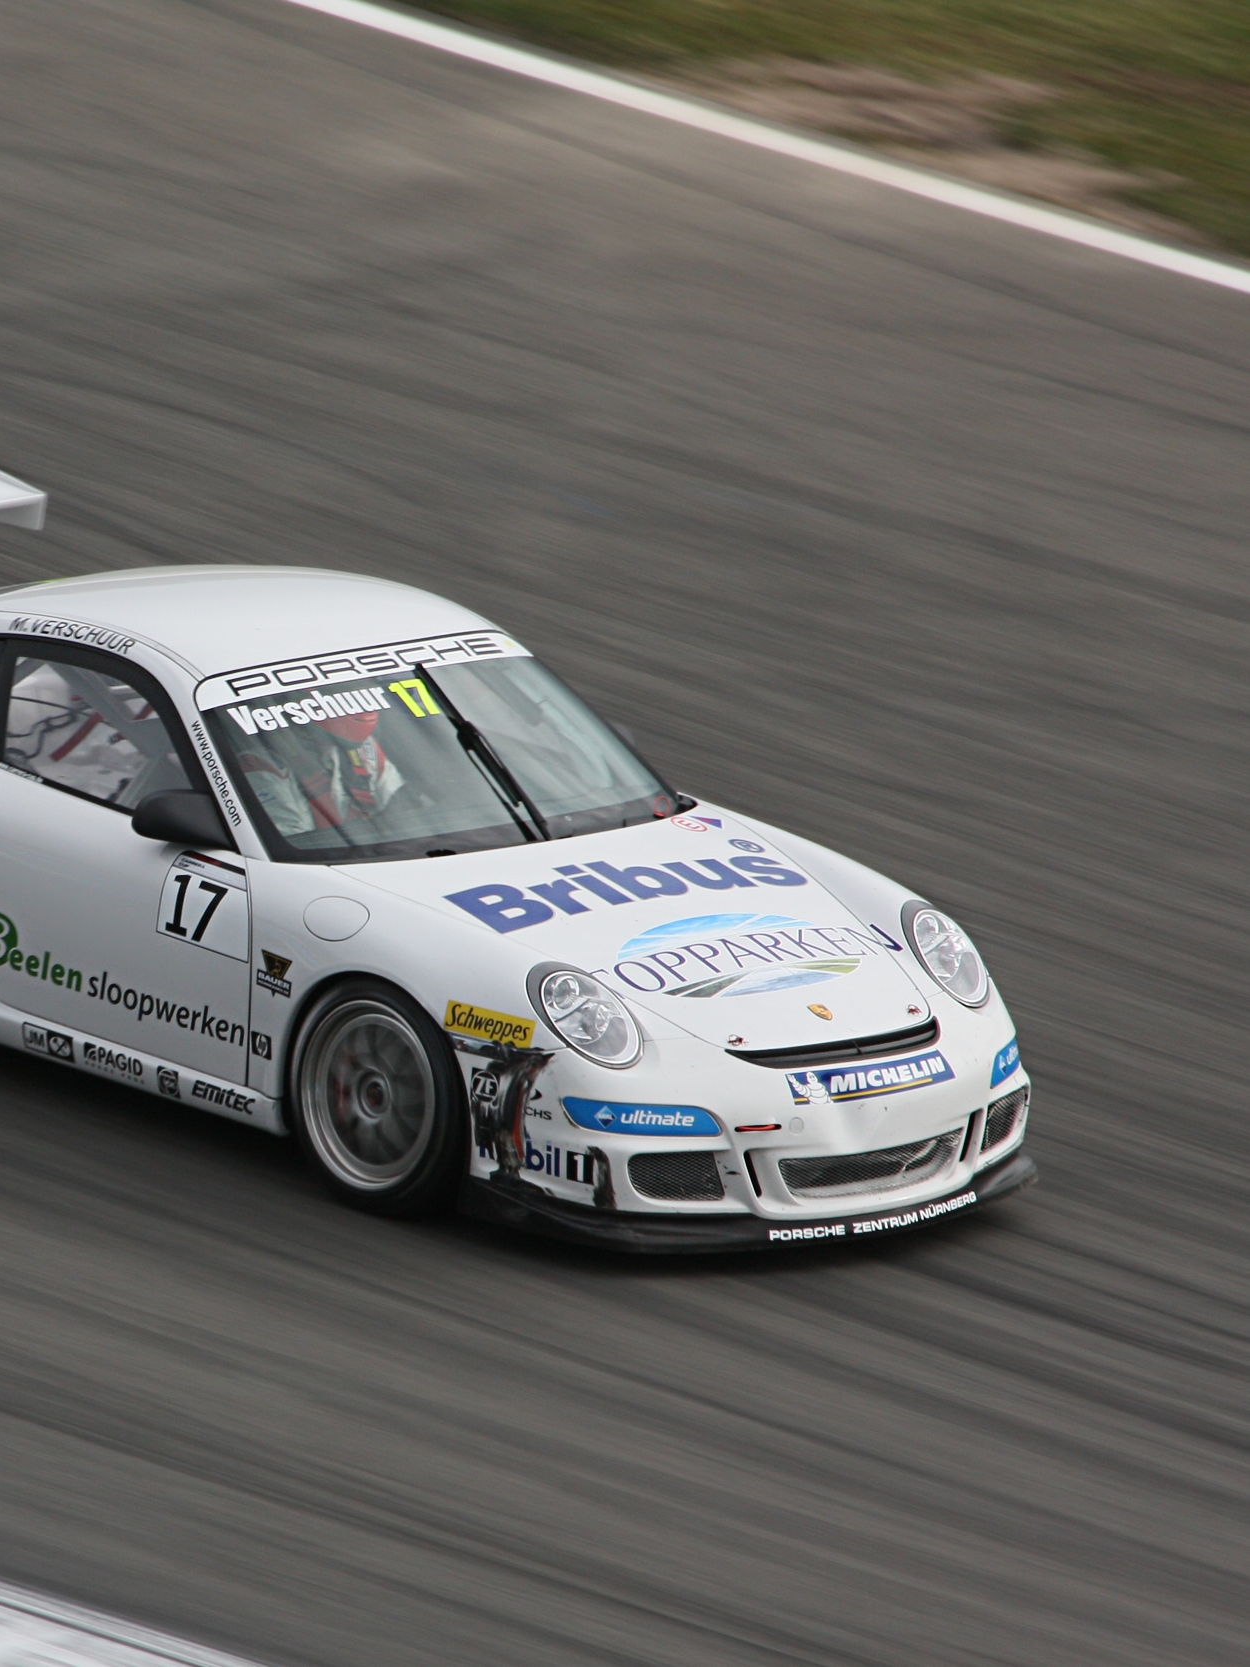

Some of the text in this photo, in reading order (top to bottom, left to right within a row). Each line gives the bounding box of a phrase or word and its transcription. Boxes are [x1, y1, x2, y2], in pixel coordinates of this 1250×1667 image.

[226, 637, 505, 697] PORSCHE
[227, 678, 441, 735] Verschuur 17
[191, 720, 242, 828] www.porsche.com
[165, 874, 229, 943] 17
[588, 922, 904, 1000] OPPARKEN
[257, 970, 291, 991] BAUER
[88, 971, 246, 1047] sloopwerken
[445, 1003, 531, 1042] Schweppes
[28, 1030, 46, 1049] JM
[97, 1046, 144, 1077] PAGID
[831, 1056, 947, 1094] MICHELIN
[473, 1074, 497, 1098] ZF
[524, 1106, 552, 1120] CHS
[620, 1110, 695, 1127] ultimate
[573, 1153, 584, 1183] 1
[769, 1190, 977, 1241] PORSCHE ZENTRUM NÜRNBERG
